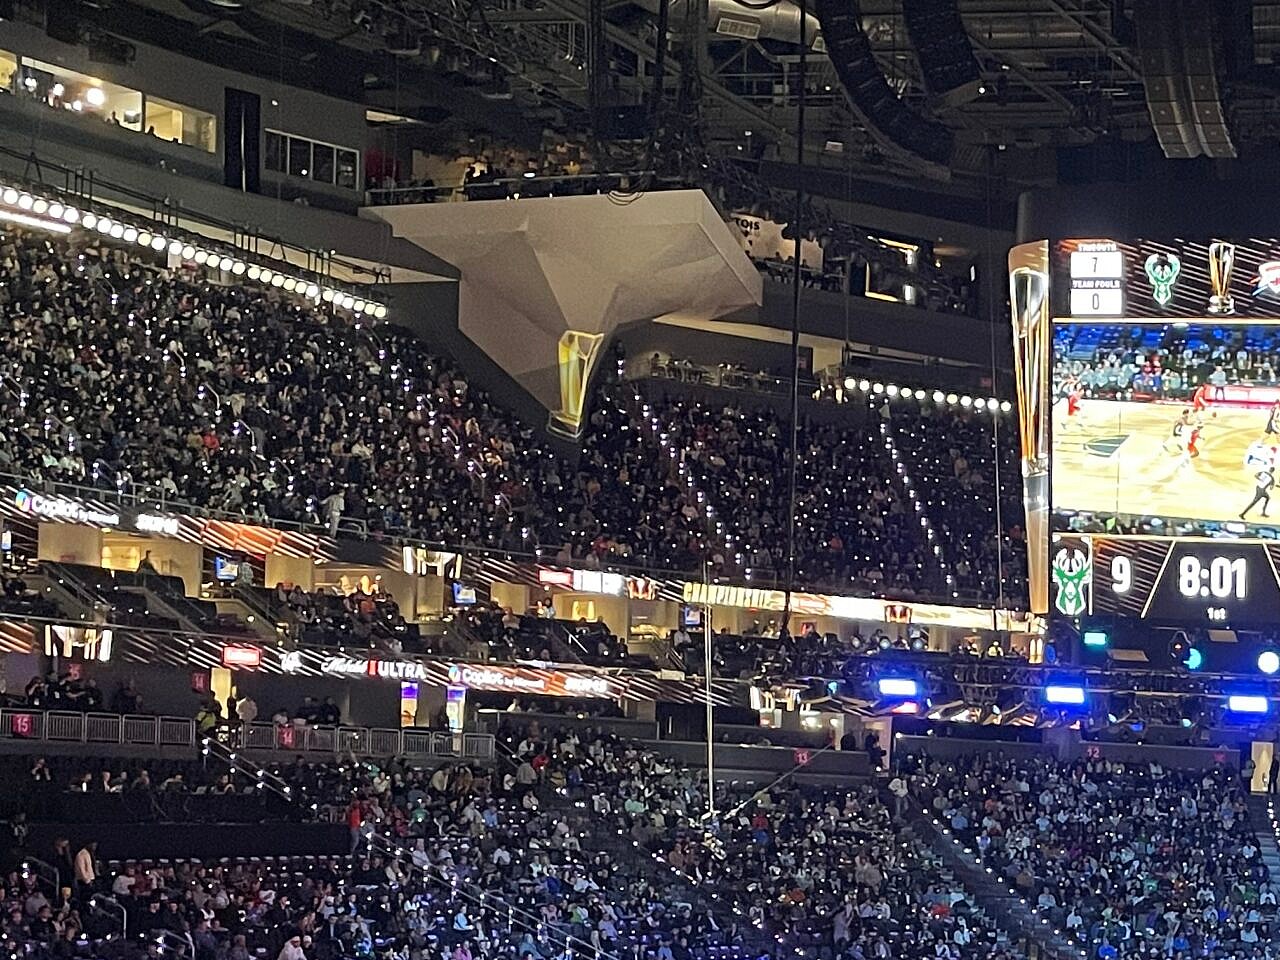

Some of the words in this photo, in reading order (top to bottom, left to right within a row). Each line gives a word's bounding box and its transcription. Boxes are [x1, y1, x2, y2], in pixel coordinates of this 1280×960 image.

[1092, 257, 1098, 273] 7
[1092, 293, 1099, 309] 0
[1111, 556, 1131, 593] 9
[1179, 556, 1247, 598] 8:01
[1208, 607, 1226, 619] 1st
[378, 661, 426, 679] ULTRA
[463, 668, 503, 685] Copilot
[16, 717, 28, 732] 15
[798, 752, 808, 764] 13
[1088, 748, 1099, 758] 12
